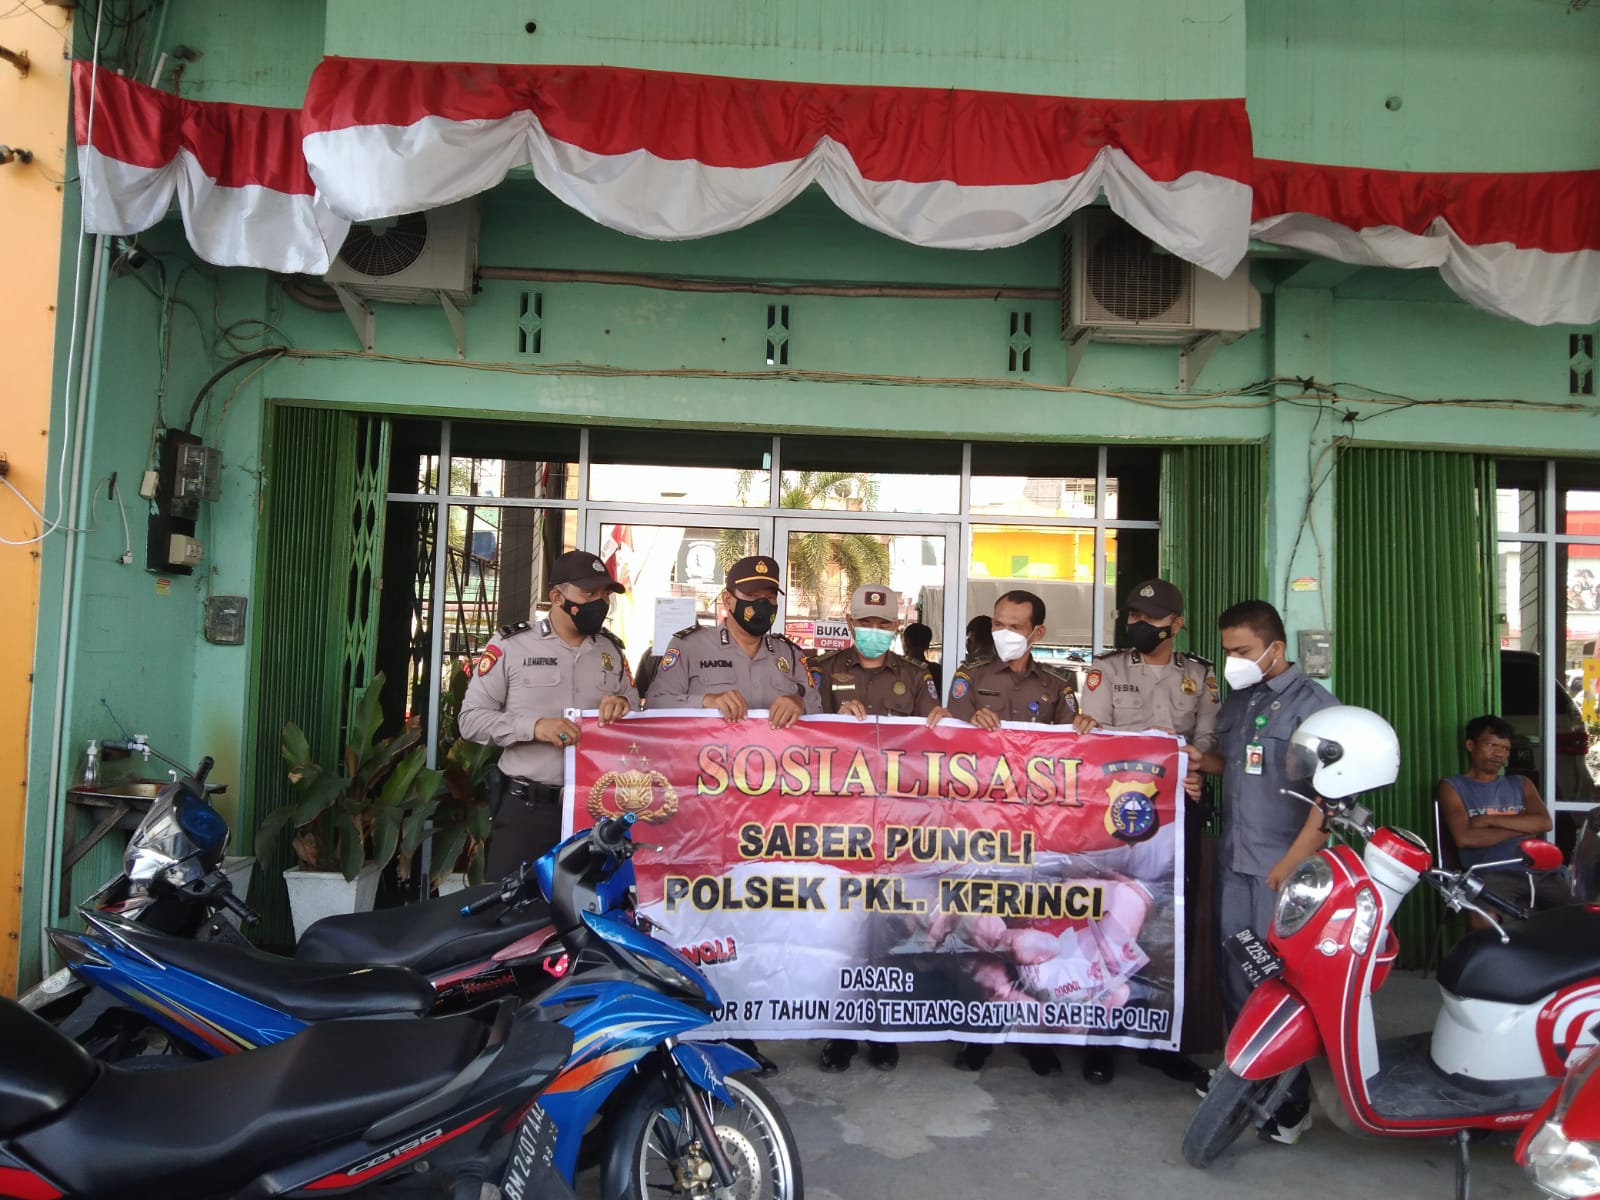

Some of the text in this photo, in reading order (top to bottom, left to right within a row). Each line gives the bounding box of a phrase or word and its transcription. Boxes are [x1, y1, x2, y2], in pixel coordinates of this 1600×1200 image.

[817, 626, 849, 637] BUKA
[820, 640, 844, 648] OPEN
[699, 659, 732, 669] HAKIM
[696, 744, 1083, 807] SOSIALISASI
[1109, 762, 1160, 774] RIAU
[739, 822, 1034, 866] SABER PUNGLI
[664, 875, 1104, 920] POLSEK PKL. KERINCI
[1236, 929, 1279, 975] BM 2256 IK
[713, 999, 1168, 1032] OR 87 TAHUN 2016 TENTANG SATUAN SABER POLRI
[514, 1124, 538, 1177] 2407
[505, 1170, 526, 1200] BM
